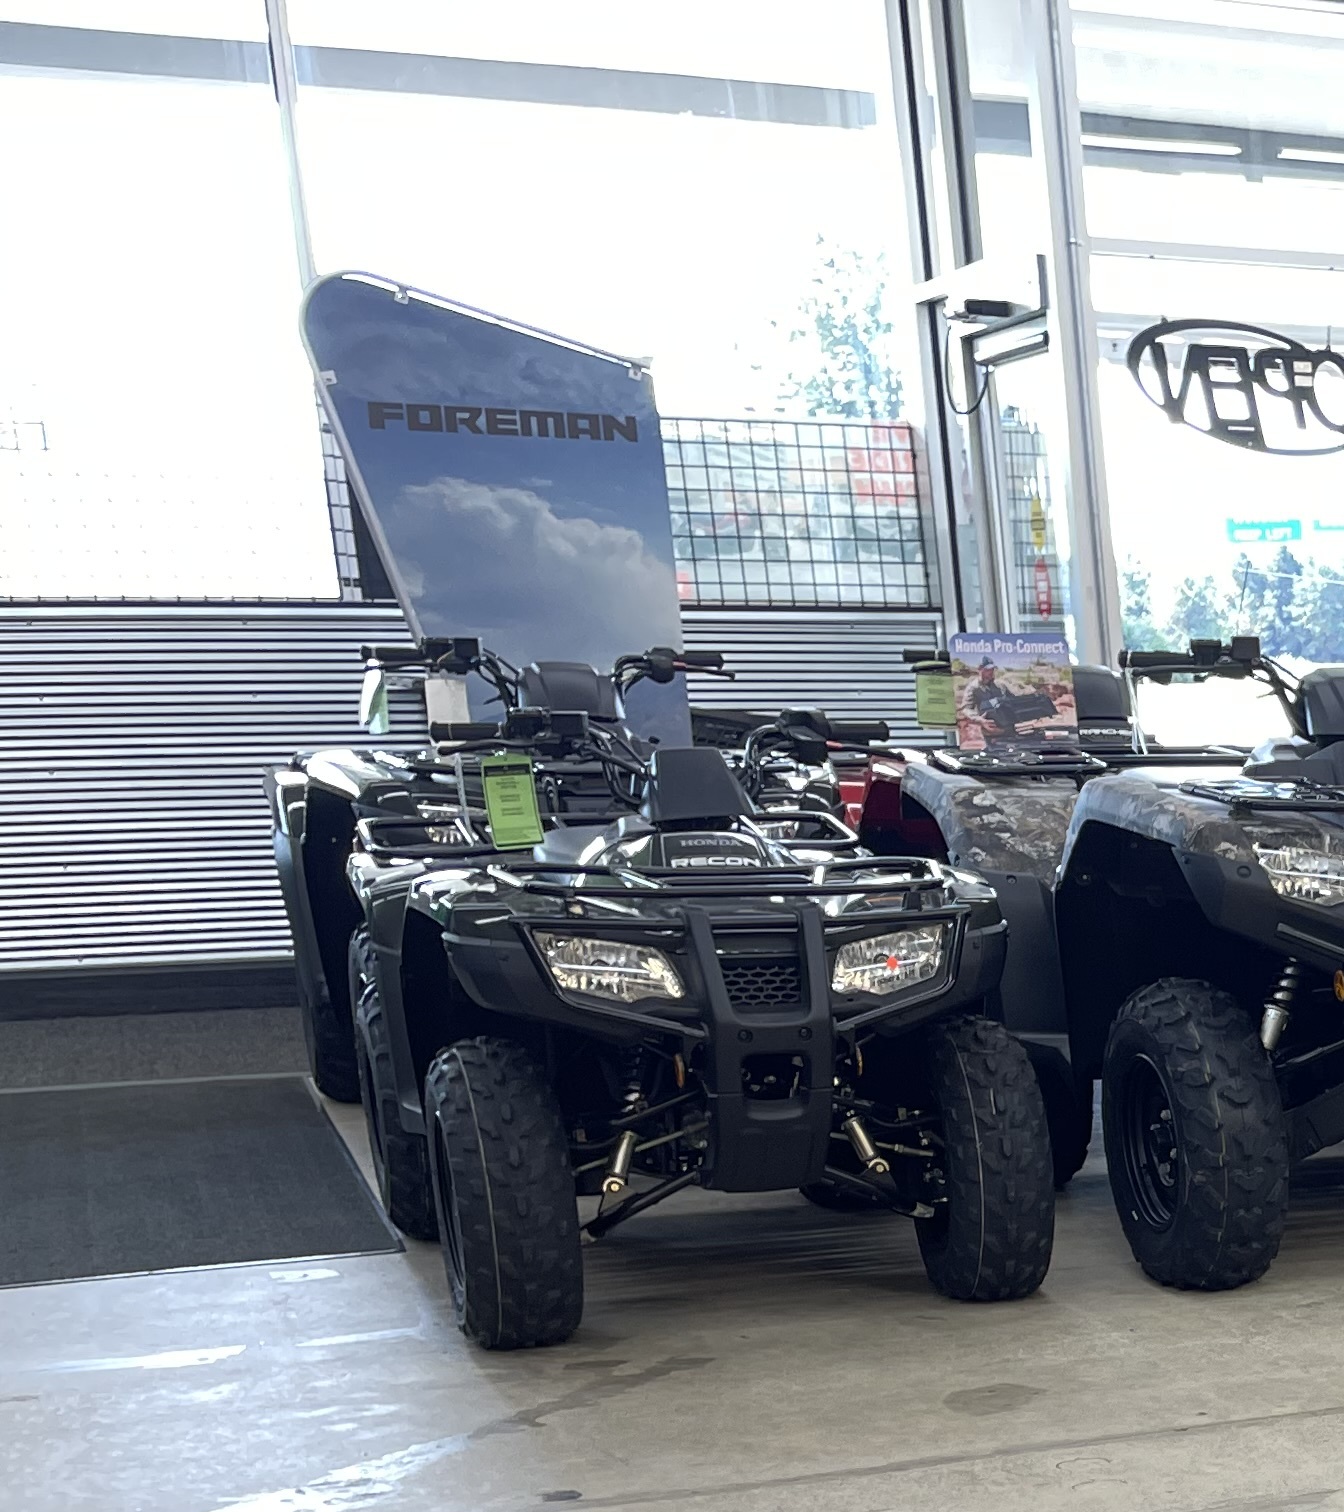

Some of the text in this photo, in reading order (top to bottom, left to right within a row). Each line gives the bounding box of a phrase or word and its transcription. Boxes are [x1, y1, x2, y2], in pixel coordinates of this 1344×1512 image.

[367, 401, 639, 443] FOREMAN
[955, 638, 1066, 654] Honda Pro-Connect
[680, 839, 742, 847] HONDA
[671, 856, 761, 869] RECON
